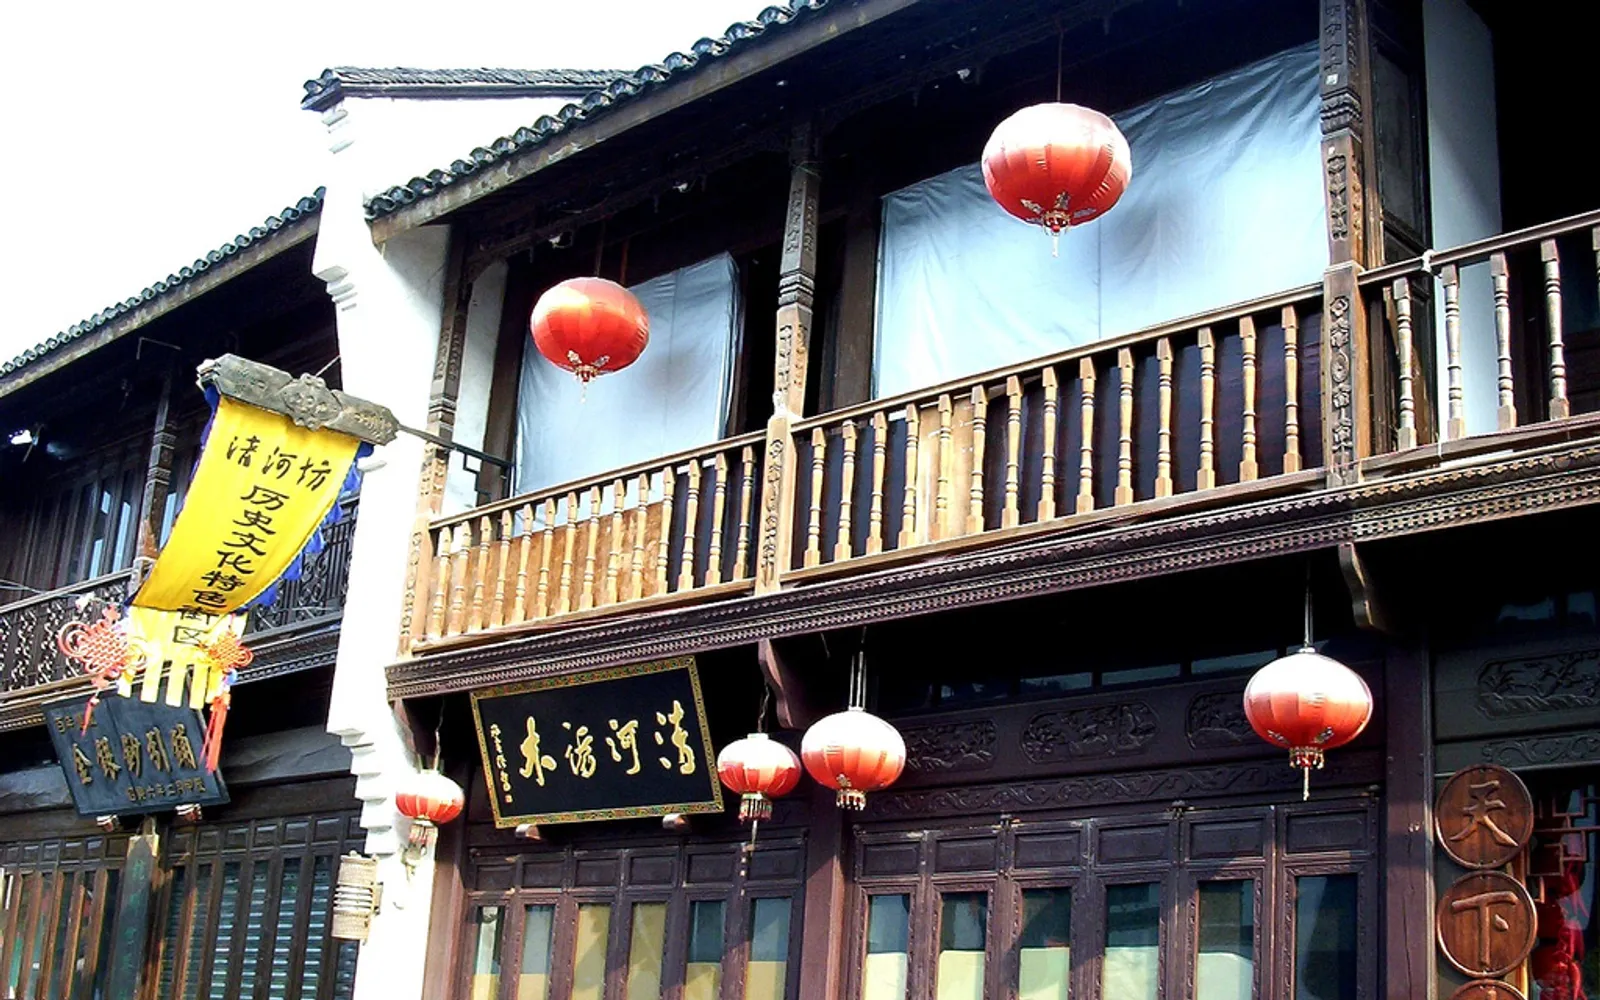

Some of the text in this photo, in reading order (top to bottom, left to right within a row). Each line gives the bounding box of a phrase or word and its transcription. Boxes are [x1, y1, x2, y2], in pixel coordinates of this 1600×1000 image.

[226, 435, 332, 491] 清河坊
[172, 485, 290, 649] 历史文化特色街区
[1450, 780, 1519, 1000] 天下
